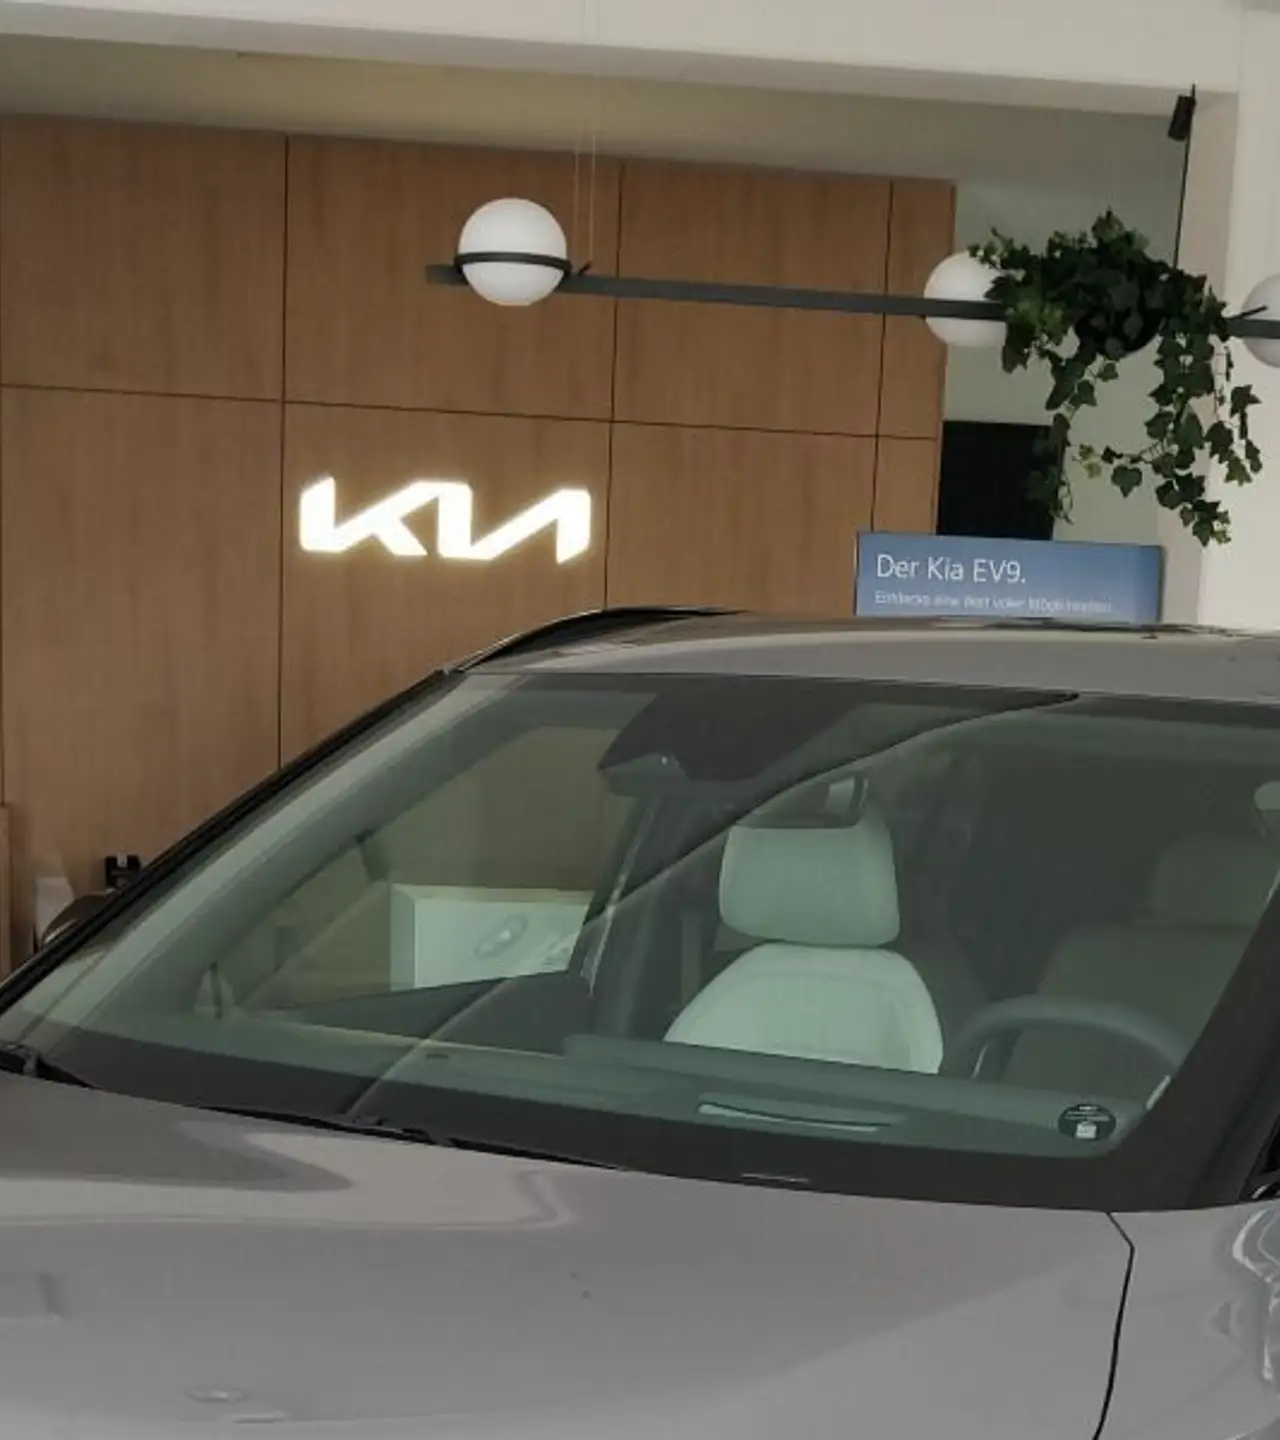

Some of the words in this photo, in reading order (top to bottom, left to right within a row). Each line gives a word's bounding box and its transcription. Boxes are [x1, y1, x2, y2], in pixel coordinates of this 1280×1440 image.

[299, 475, 592, 565] KIA
[876, 553, 920, 579] Der
[927, 555, 965, 582] Kia
[972, 558, 1027, 585] EV9.
